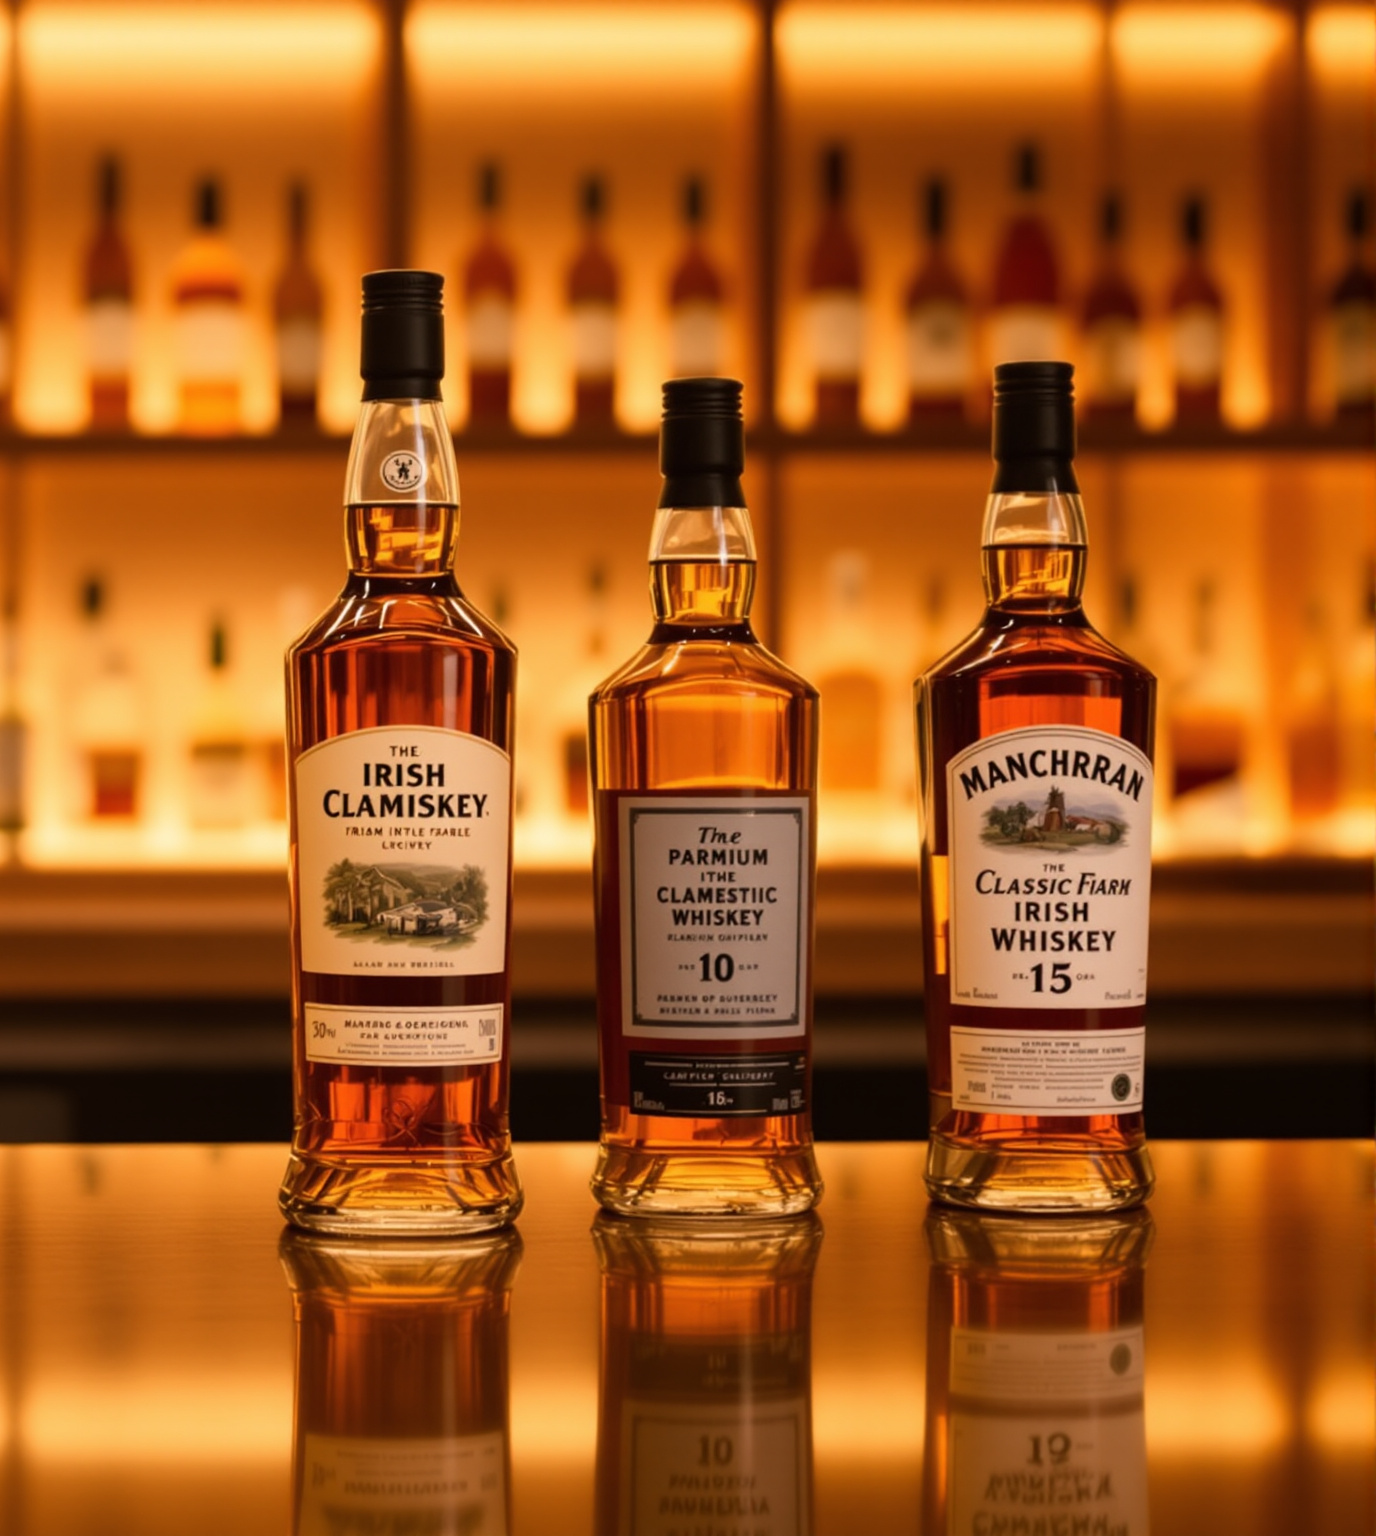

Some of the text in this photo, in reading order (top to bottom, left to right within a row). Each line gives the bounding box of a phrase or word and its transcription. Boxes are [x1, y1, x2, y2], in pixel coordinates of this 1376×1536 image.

[390, 745, 420, 757] THE
[363, 763, 445, 787] IRISH
[958, 749, 1145, 802] MANCHRRAN
[323, 789, 488, 818] CLAMISKEY
[668, 849, 768, 866] PARMIUM
[656, 886, 778, 904] CLAMESTIIC
[671, 909, 764, 926] WHISKEY
[1015, 902, 1089, 922] IRISH
[990, 928, 1117, 952] WHISKEY
[699, 952, 735, 982] 10
[1030, 962, 1072, 994] 15
